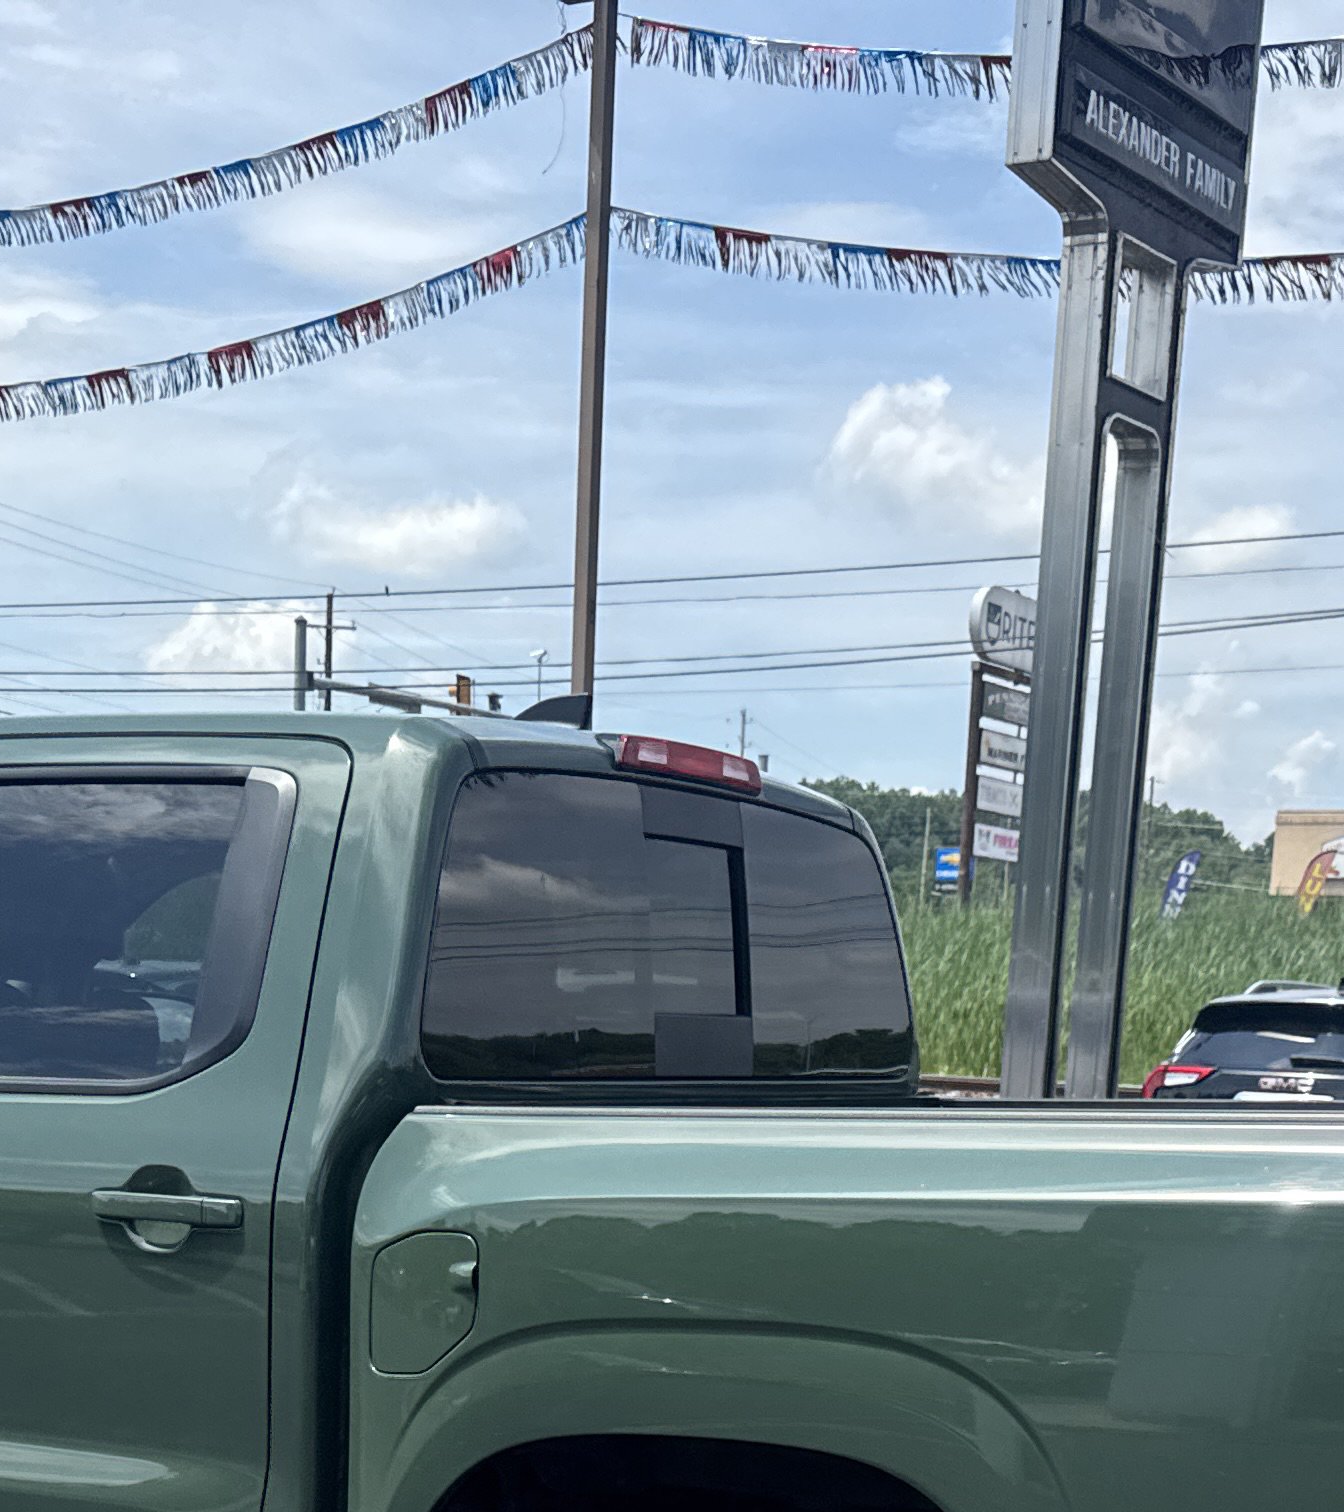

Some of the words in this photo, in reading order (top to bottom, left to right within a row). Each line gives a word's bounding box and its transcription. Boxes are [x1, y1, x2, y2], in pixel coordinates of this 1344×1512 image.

[1085, 89, 1181, 180] ALEXANDER
[1185, 151, 1236, 211] FAMILY
[1258, 1077, 1315, 1093] GMC
